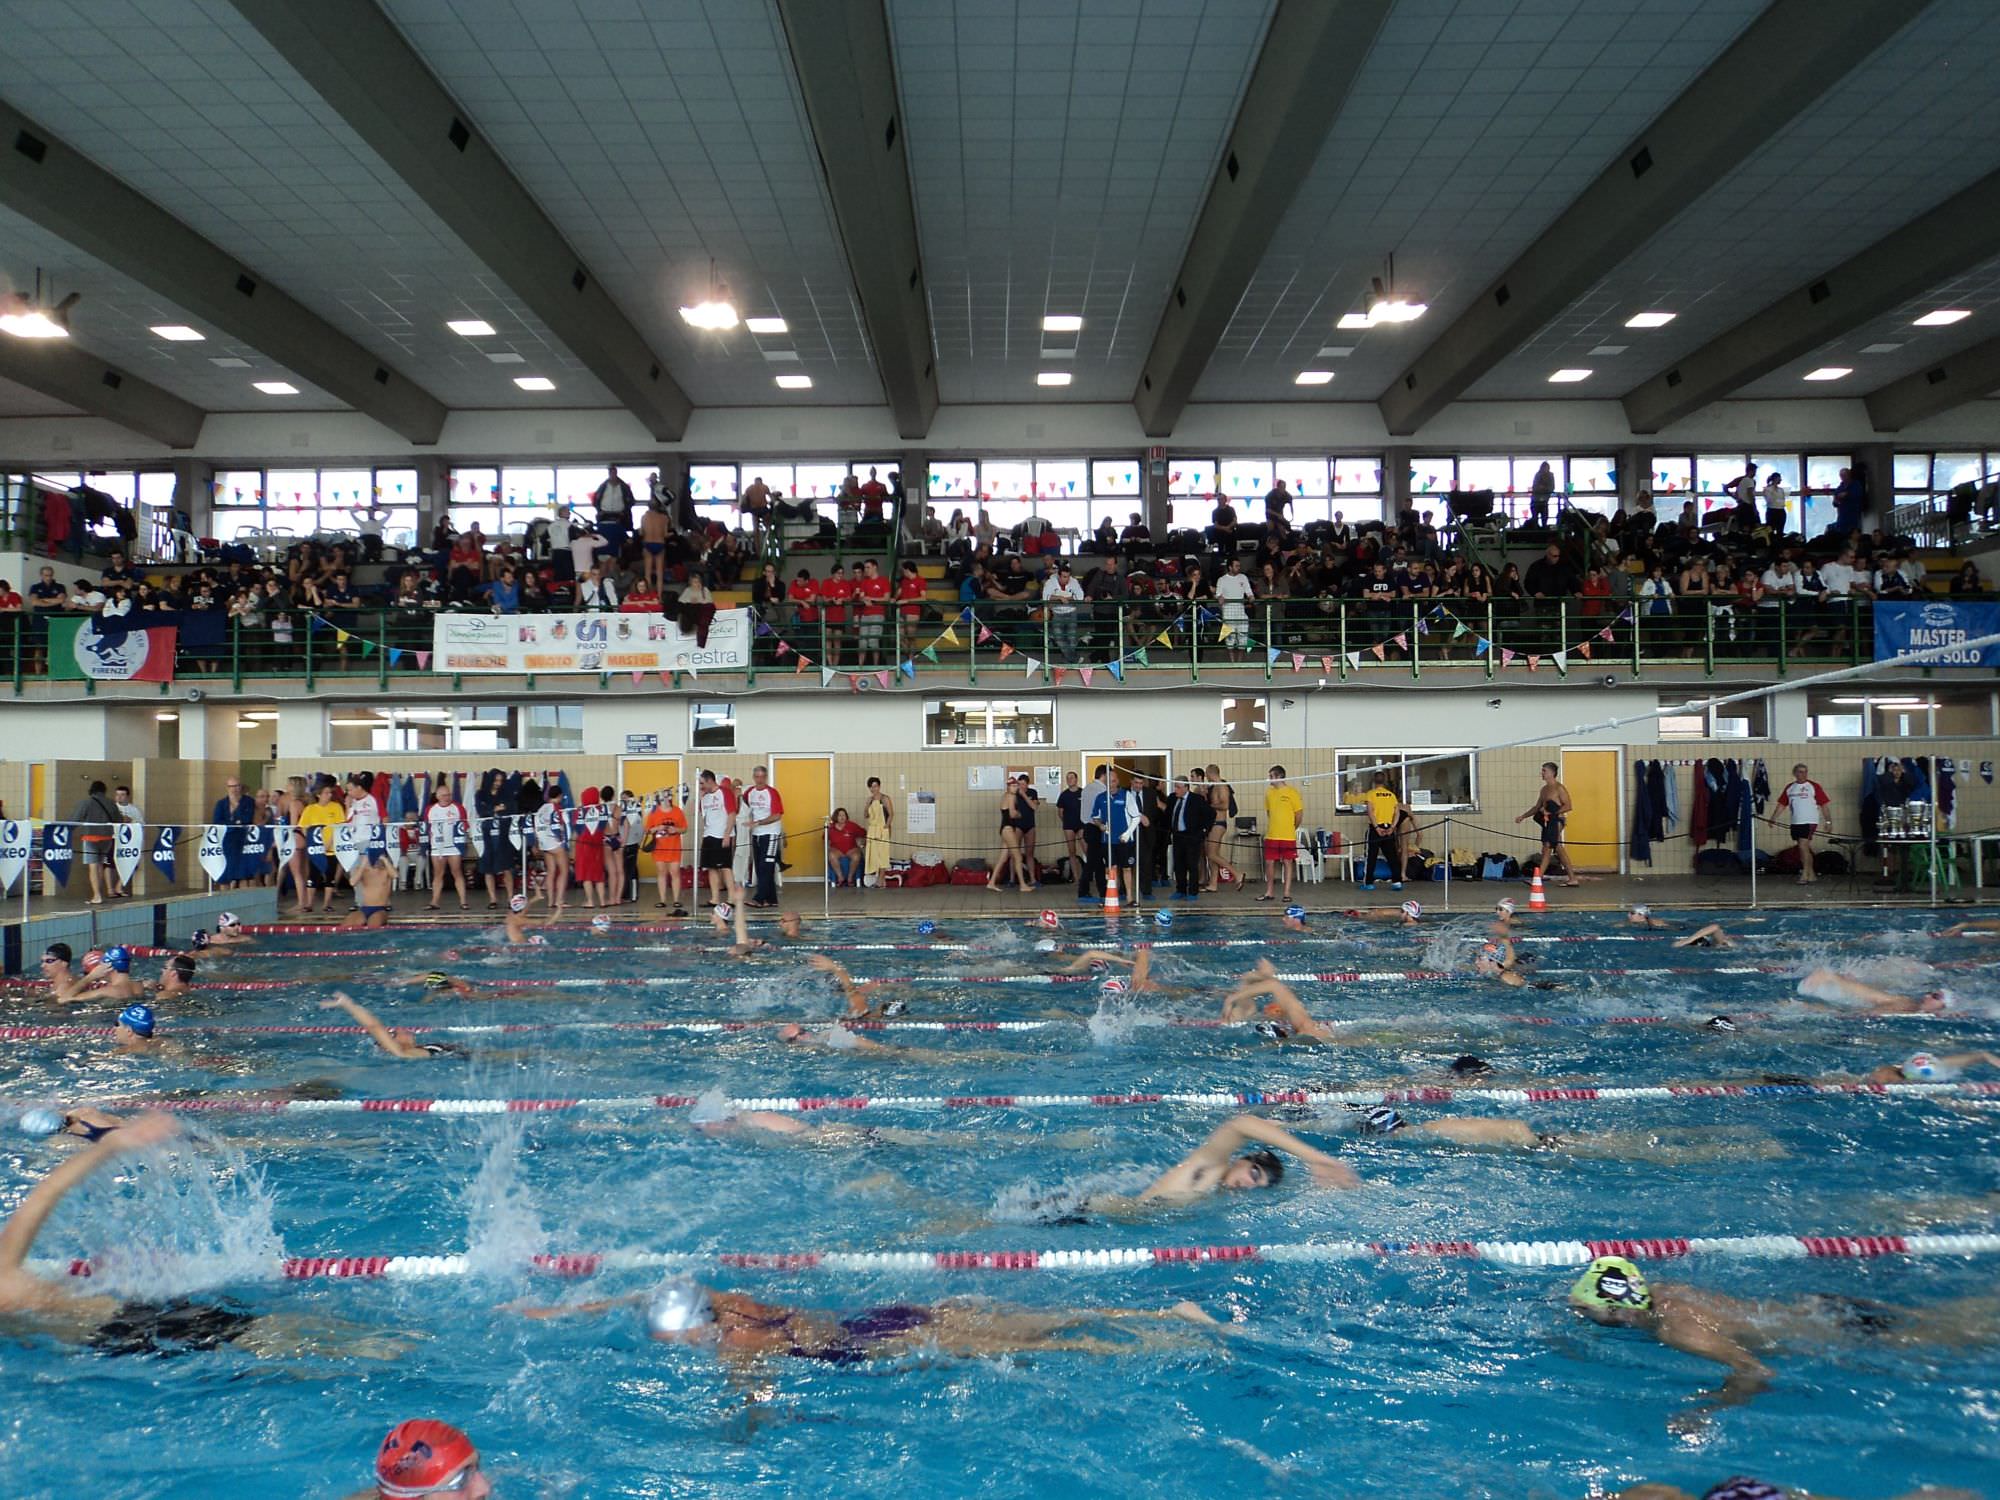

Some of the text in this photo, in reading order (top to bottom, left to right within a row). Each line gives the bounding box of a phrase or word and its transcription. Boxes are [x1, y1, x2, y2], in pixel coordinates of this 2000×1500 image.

[1909, 628, 1966, 645] MASTER
[577, 642, 607, 650] PRATO
[691, 649, 738, 664] estra
[1943, 649, 1981, 663] SOLO
[92, 667, 128, 675] FIRENZE
